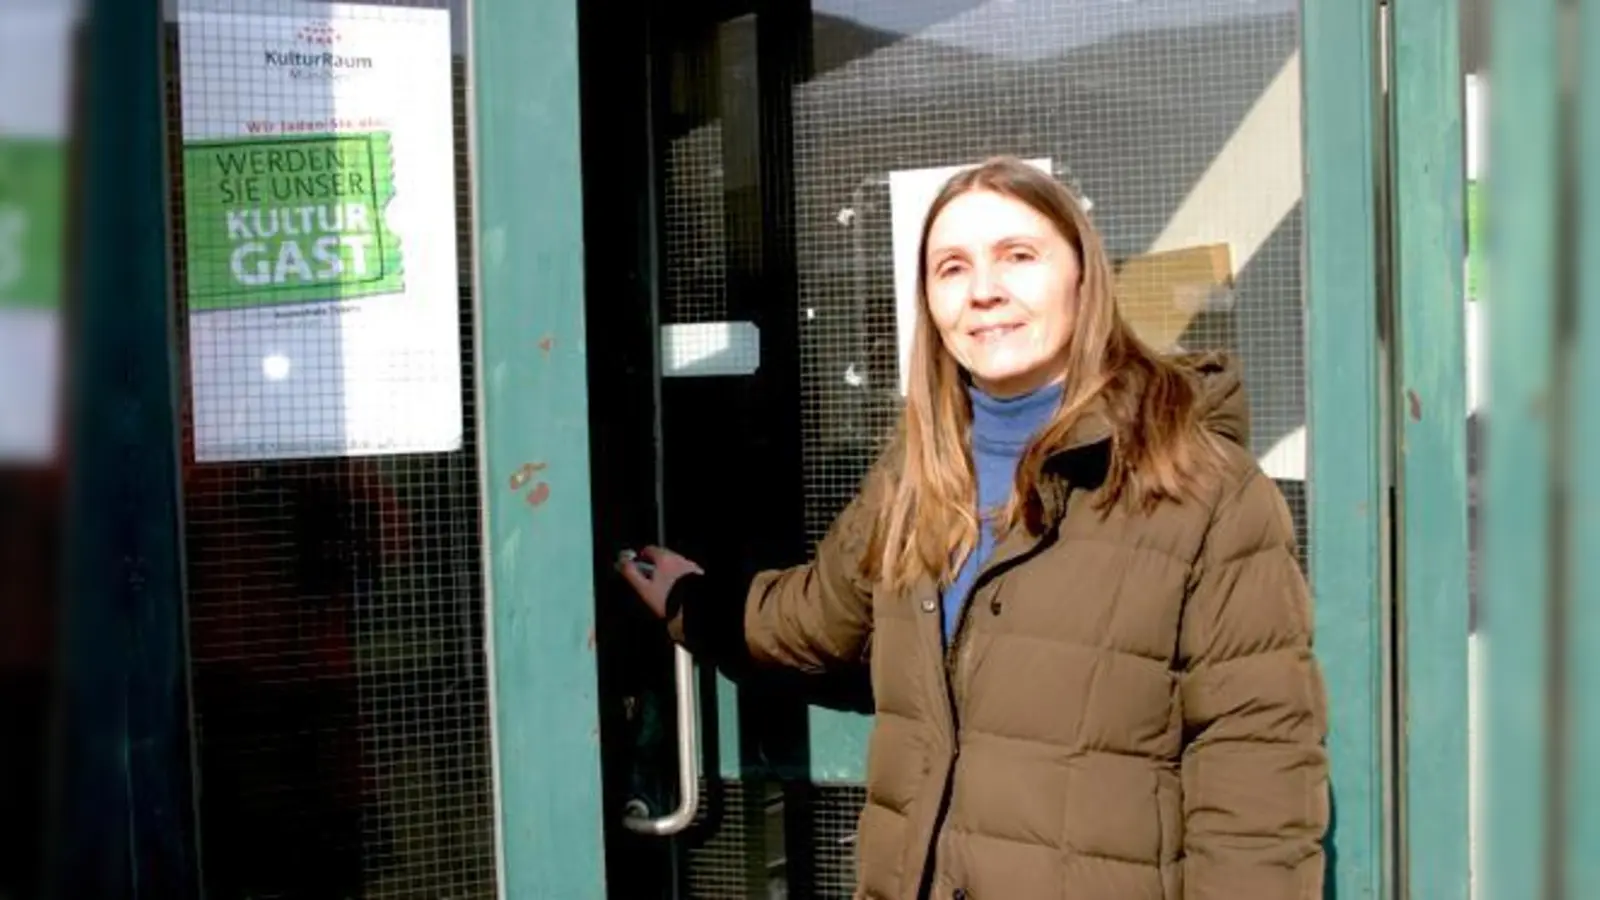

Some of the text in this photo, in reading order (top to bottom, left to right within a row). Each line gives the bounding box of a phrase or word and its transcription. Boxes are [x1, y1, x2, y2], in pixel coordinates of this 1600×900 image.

[263, 50, 373, 69] KulturRaum
[215, 147, 345, 176] WERDEN
[219, 172, 364, 204] SIE UNSER
[226, 203, 370, 240] KULTUR
[230, 234, 373, 285] GAST
